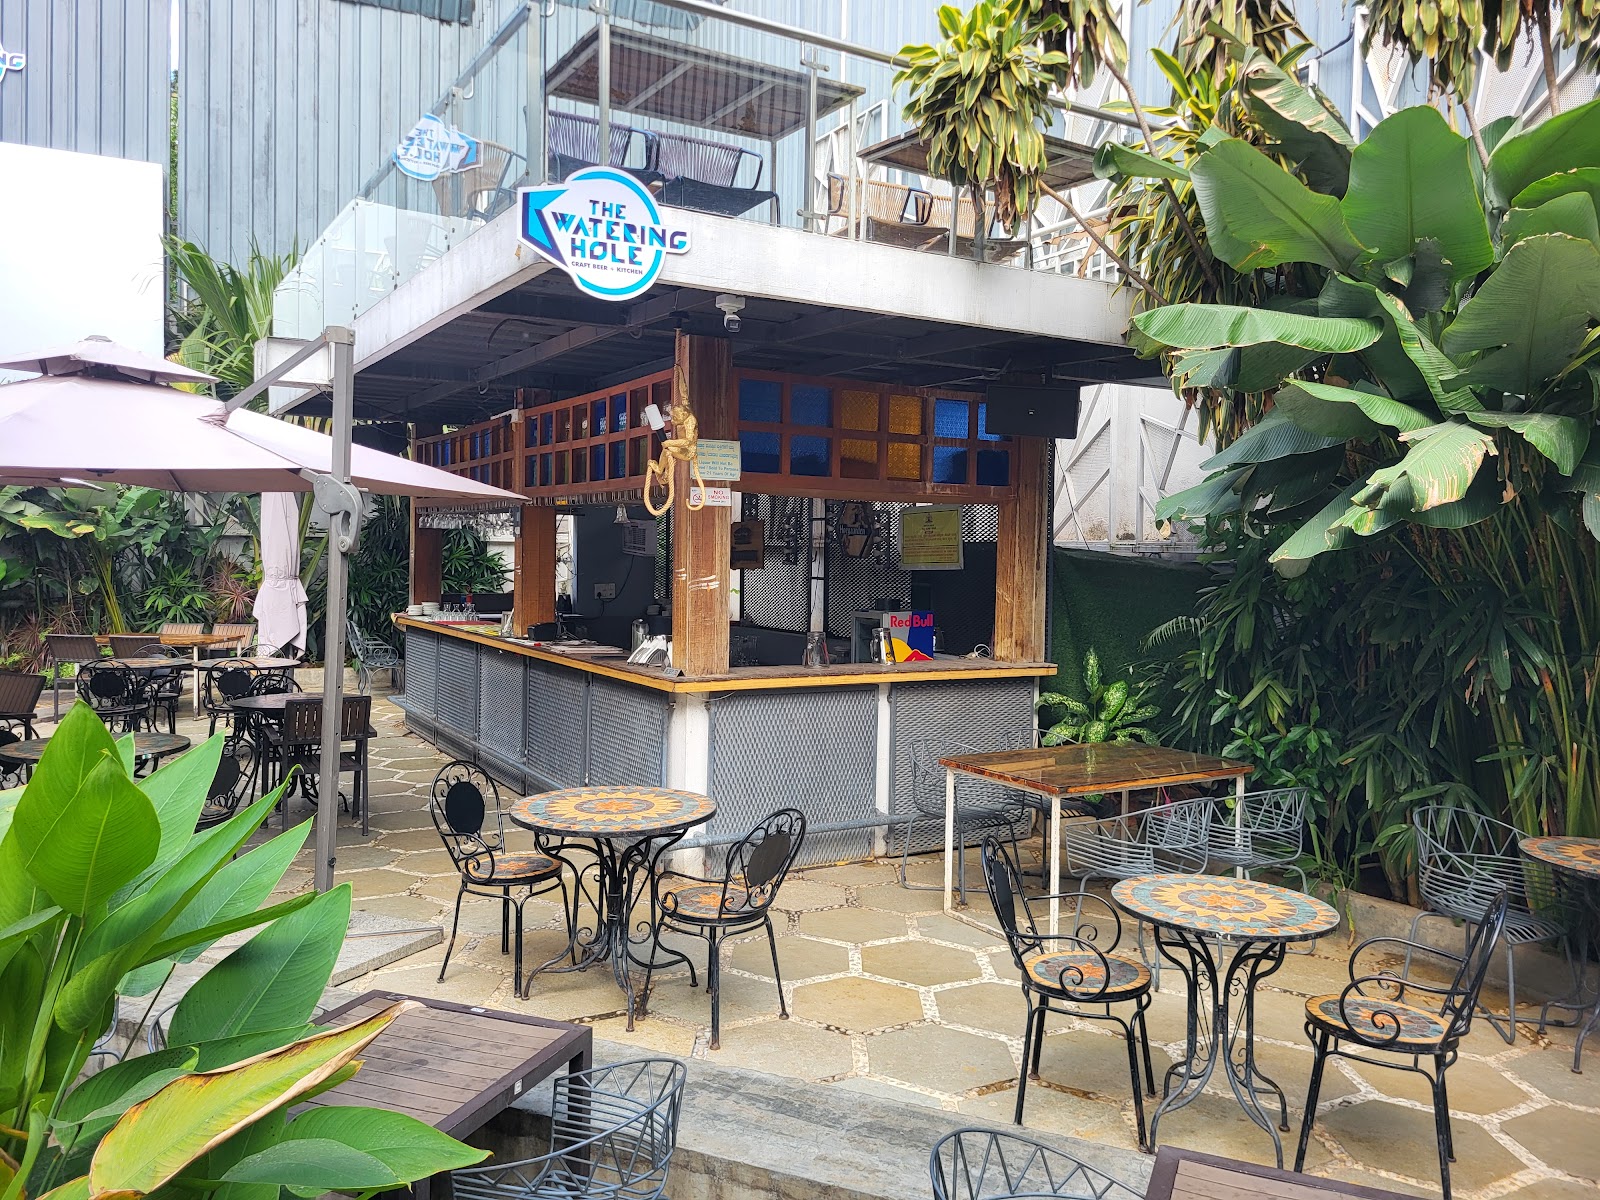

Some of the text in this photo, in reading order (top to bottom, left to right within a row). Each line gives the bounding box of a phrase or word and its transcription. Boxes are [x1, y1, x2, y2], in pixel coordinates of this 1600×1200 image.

[589, 199, 626, 219] THE
[551, 211, 687, 250] WATERING
[571, 237, 643, 266] HOLE
[571, 261, 591, 269] CRAFT
[592, 263, 608, 271] BEER
[616, 266, 643, 275] KITCHEN
[890, 614, 933, 628] Red Bull
